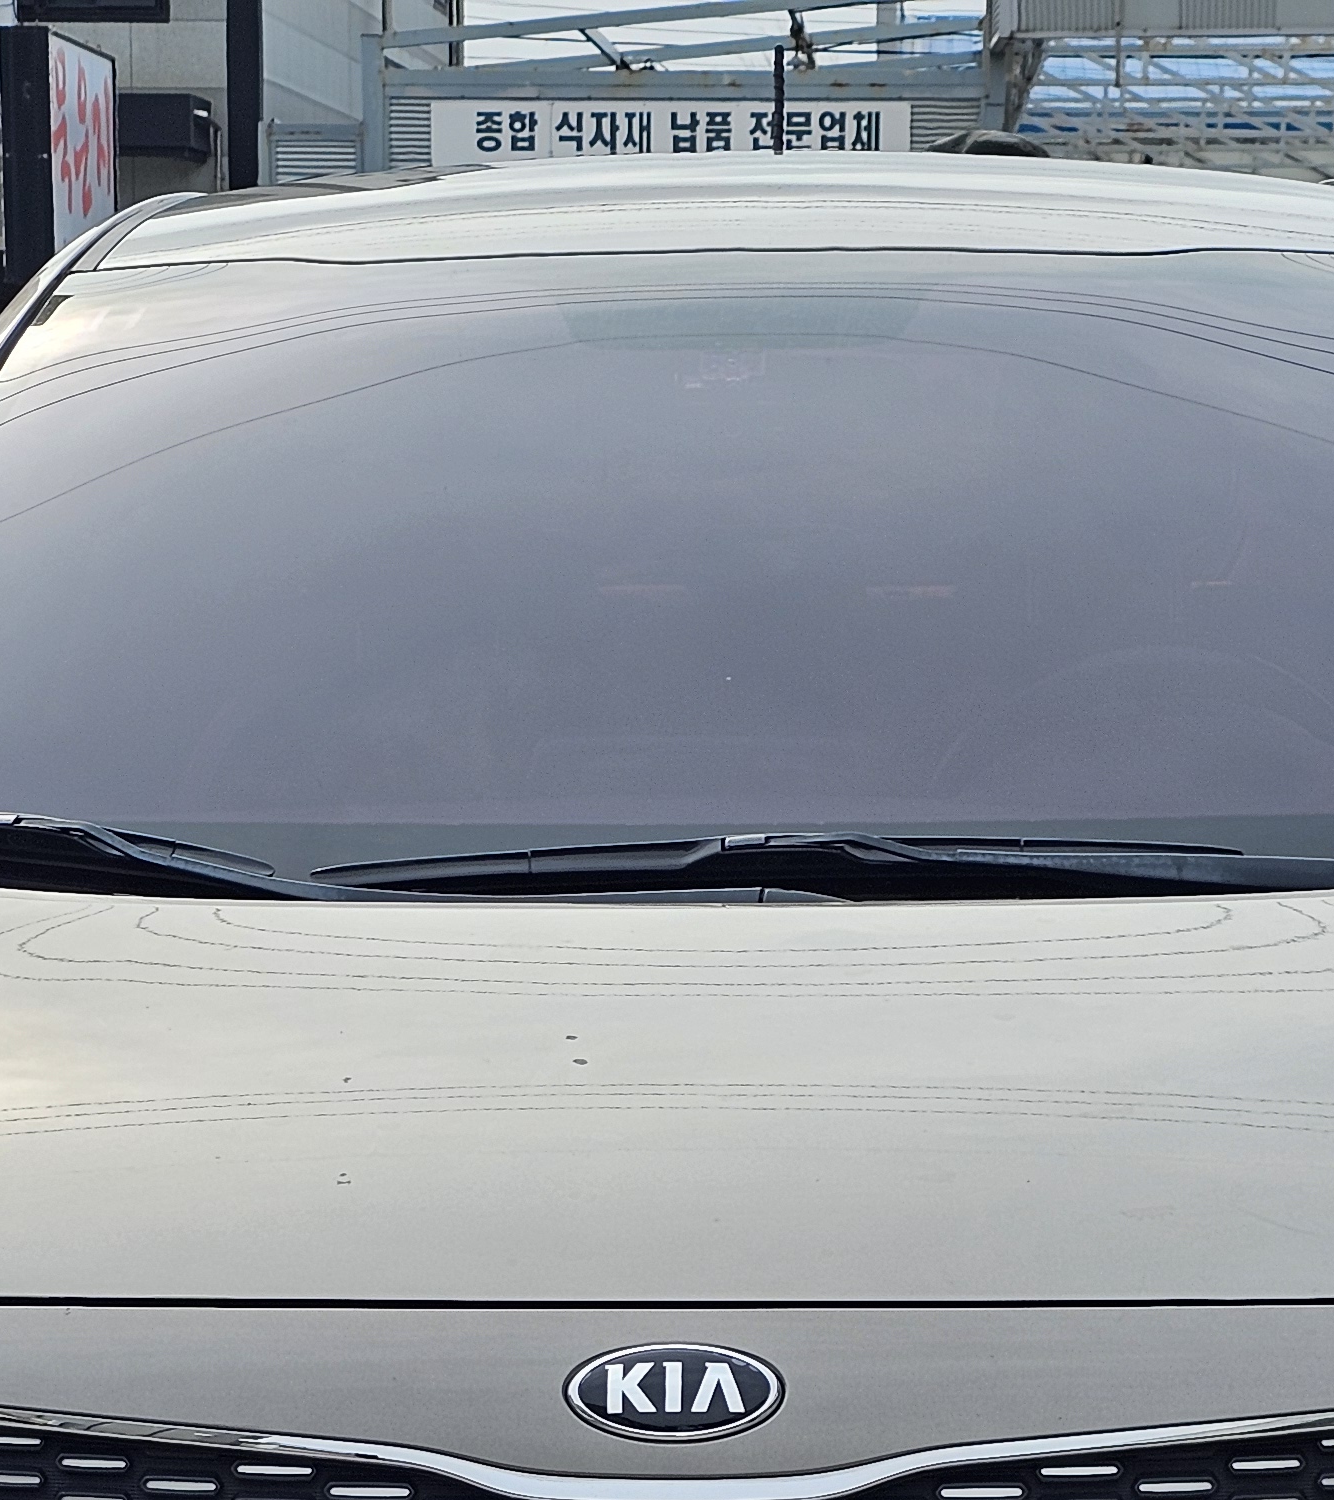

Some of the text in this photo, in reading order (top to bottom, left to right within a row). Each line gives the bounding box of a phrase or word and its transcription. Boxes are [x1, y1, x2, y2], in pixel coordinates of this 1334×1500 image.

[475, 110, 881, 155] 종합 식자재 납품 전문업체
[605, 1361, 746, 1414] KIA
